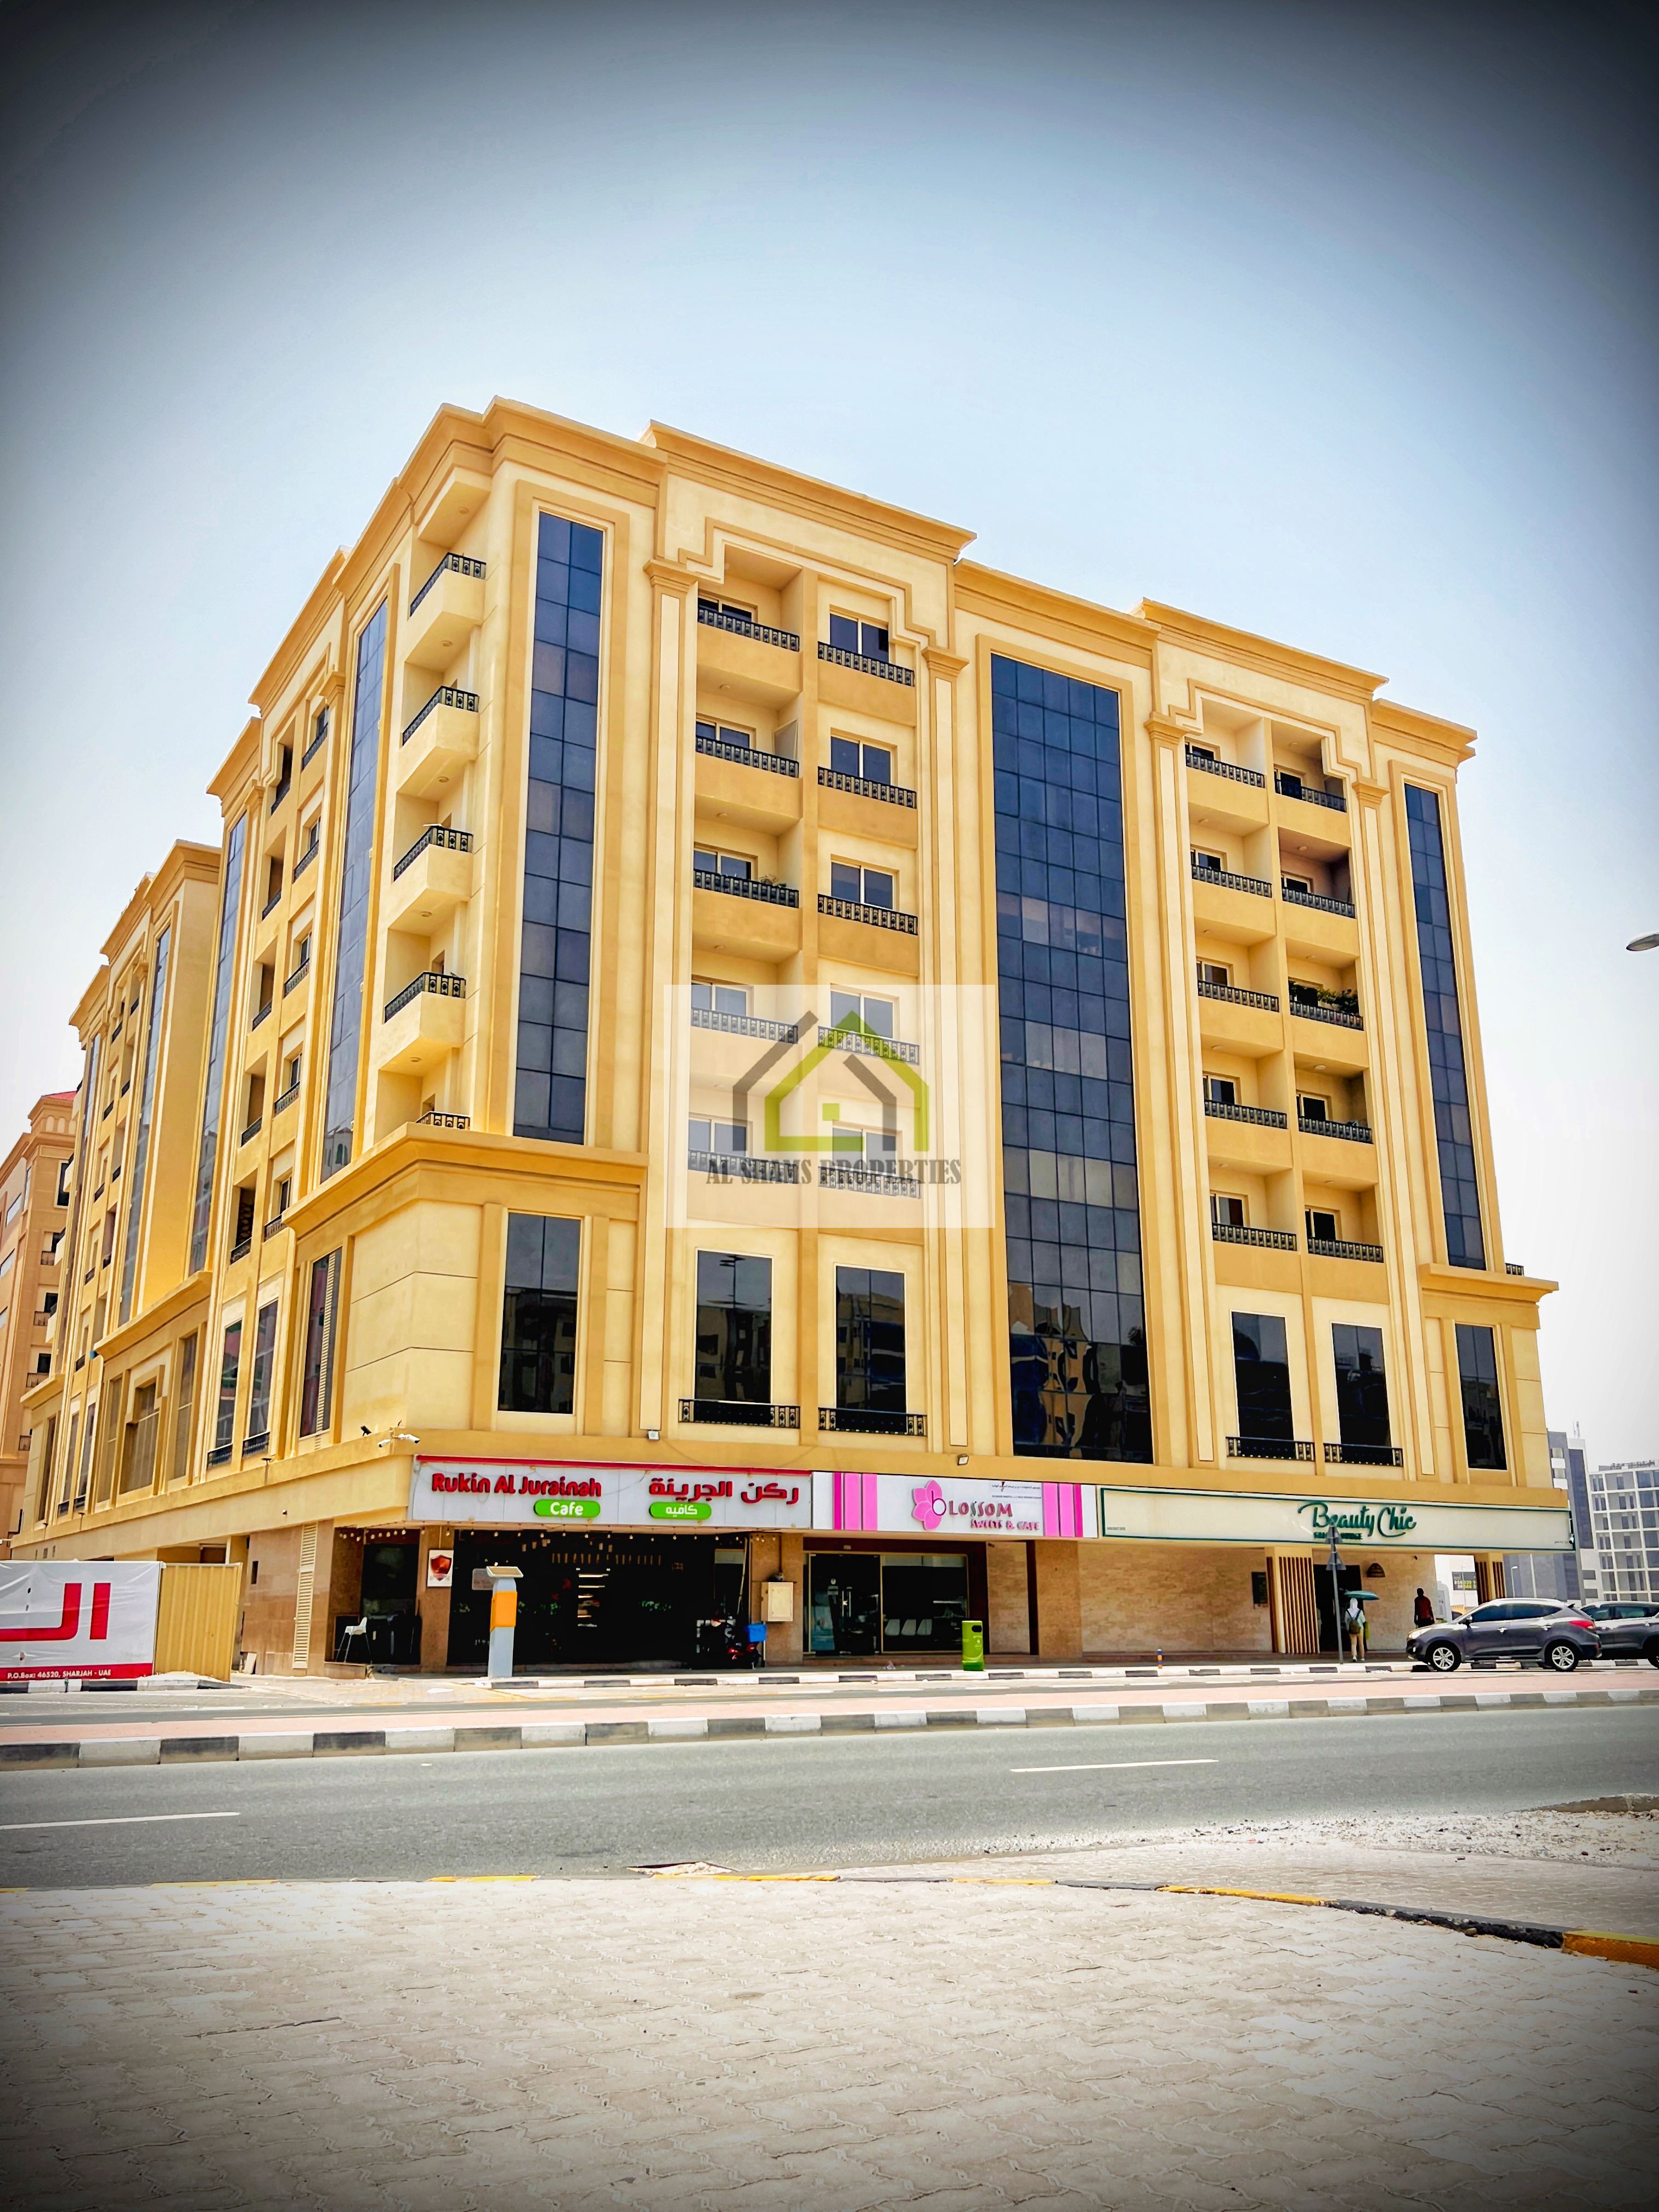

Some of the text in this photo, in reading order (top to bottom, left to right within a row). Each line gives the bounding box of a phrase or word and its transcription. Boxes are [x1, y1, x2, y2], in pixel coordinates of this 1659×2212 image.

[432, 1472, 601, 1497] Rukin Al Jurainah
[648, 1477, 799, 1505] ركن الجرينة
[550, 1502, 584, 1516] Cafe
[665, 1504, 698, 1518] كافيه
[970, 1519, 1002, 1529] SWEETS
[1017, 1521, 1040, 1531] CAFE
[1297, 1500, 1417, 1538] Beauty Chic
